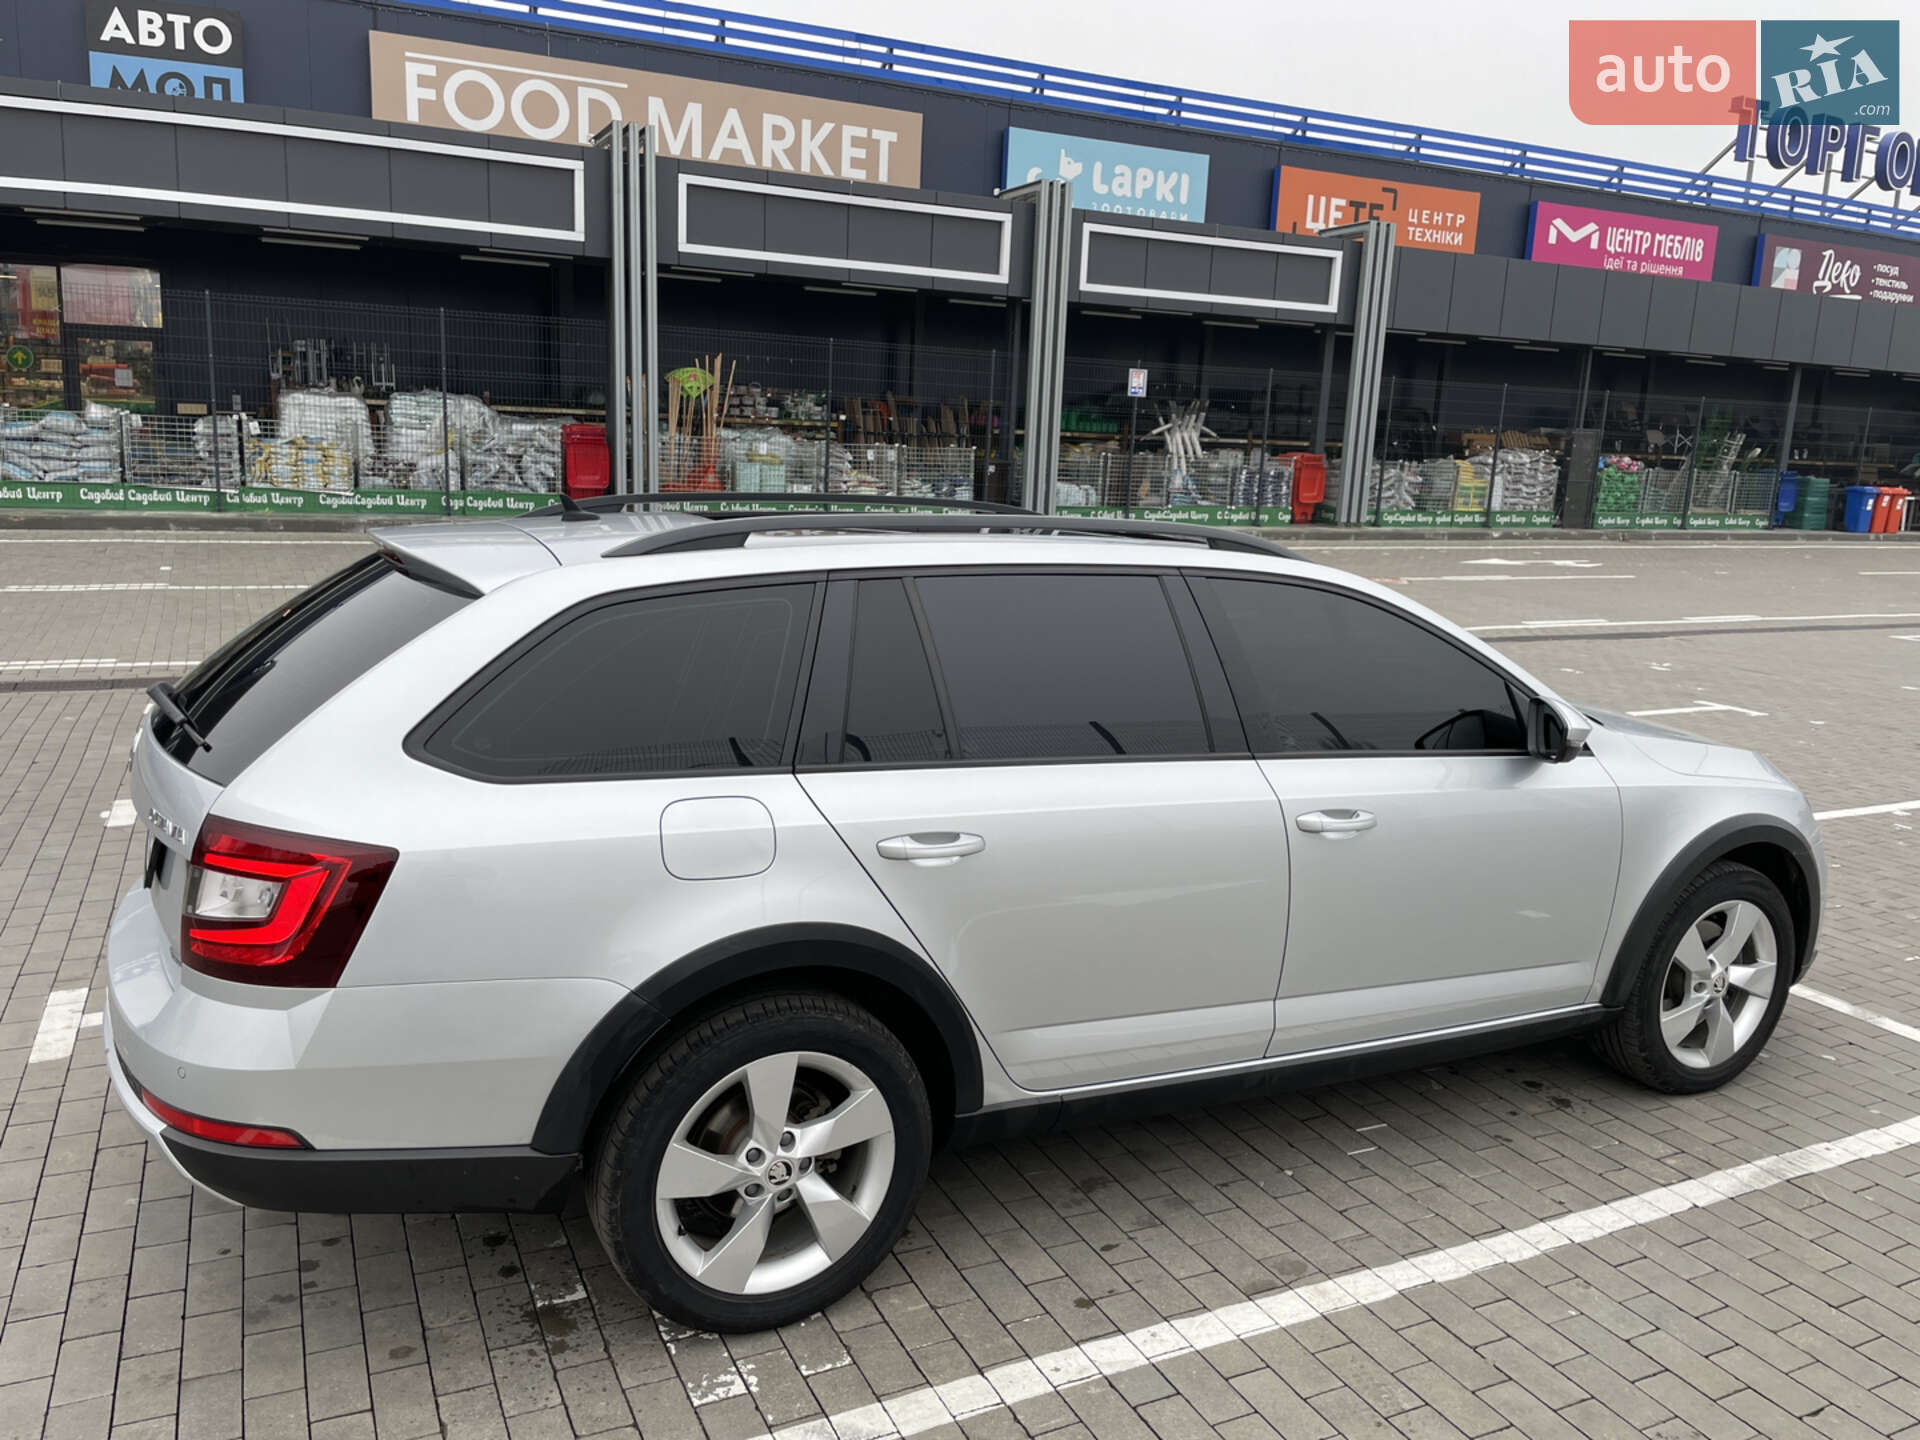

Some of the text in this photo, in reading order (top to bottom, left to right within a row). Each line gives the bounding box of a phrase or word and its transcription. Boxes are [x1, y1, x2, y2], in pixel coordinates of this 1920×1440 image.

[100, 6, 233, 55] АВТО
[404, 60, 899, 183] FOOD MARKET
[1728, 95, 1920, 197] ТОРГО
[1407, 226, 1464, 246] ТЕХНІКИ
[1408, 207, 1466, 228] ЦЕНТР
[1606, 226, 1652, 256] ЦЕНТР
[1653, 233, 1705, 263] МЕБЛІВ
[1603, 254, 1684, 277] ідеї та рішення
